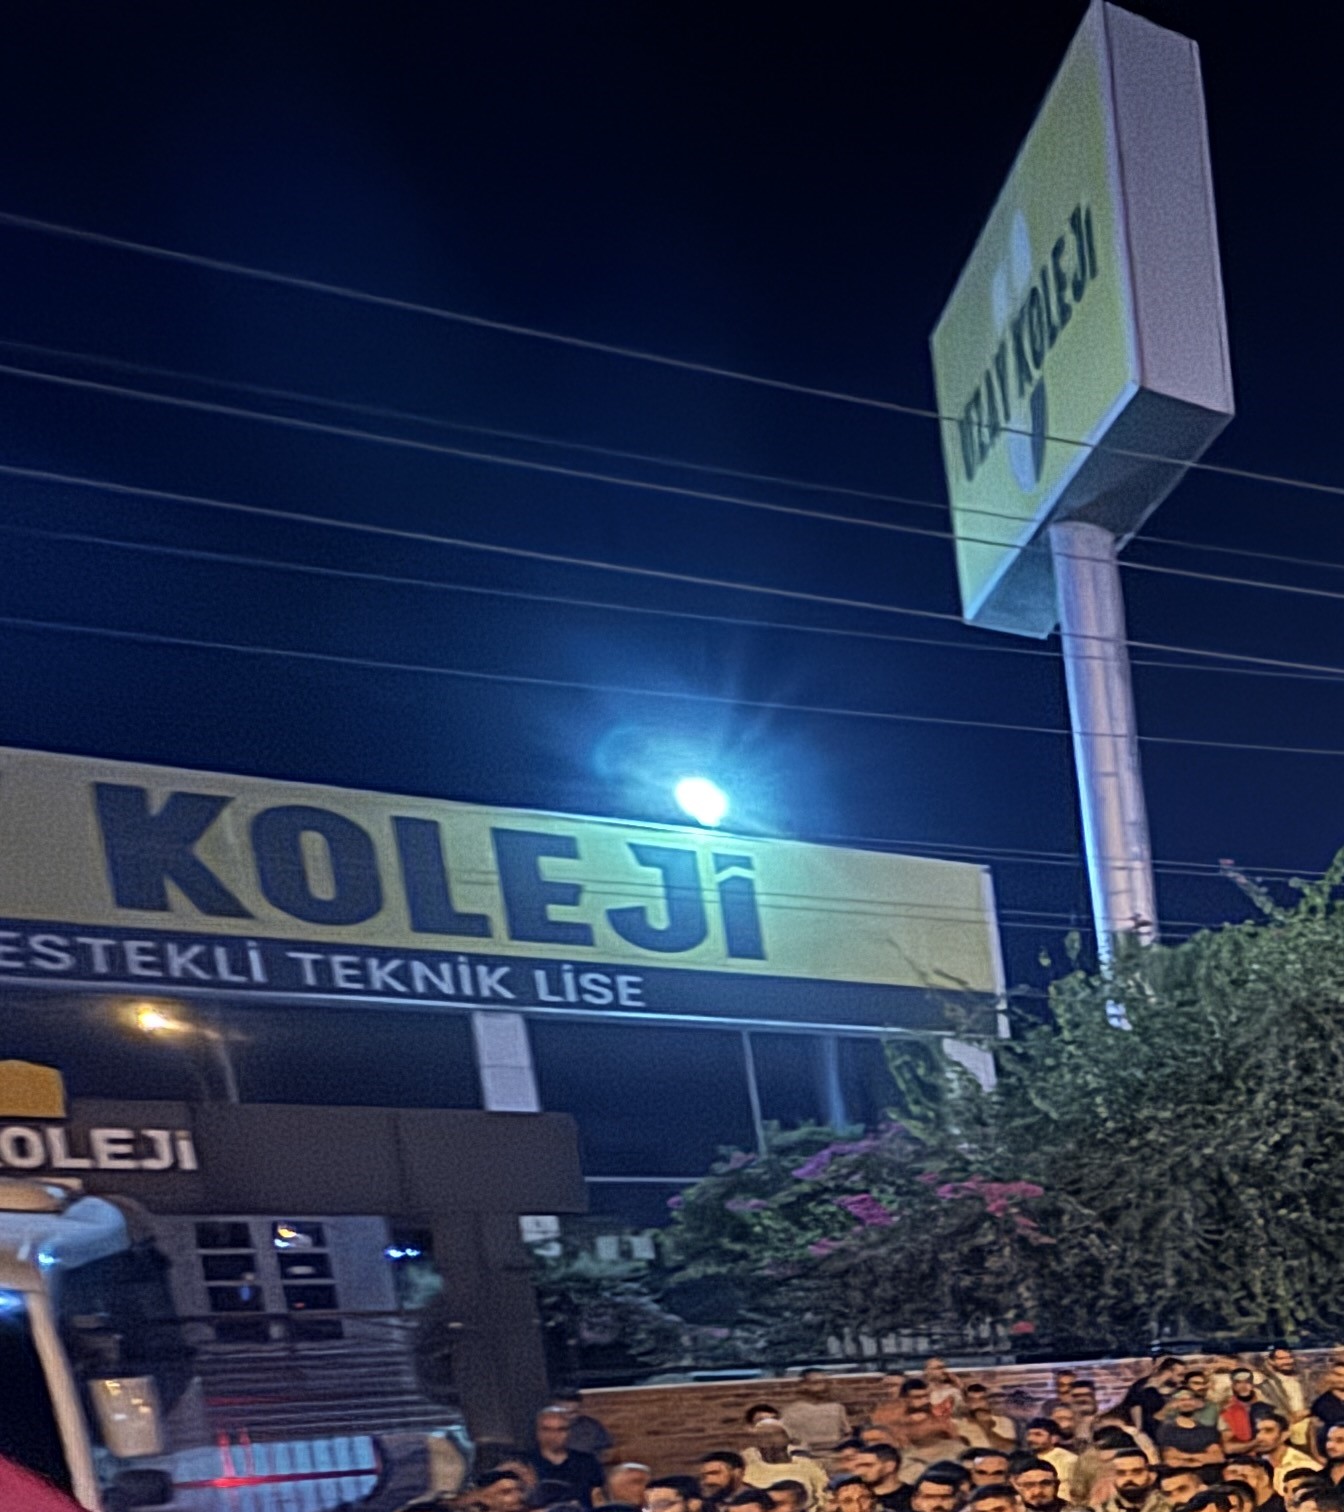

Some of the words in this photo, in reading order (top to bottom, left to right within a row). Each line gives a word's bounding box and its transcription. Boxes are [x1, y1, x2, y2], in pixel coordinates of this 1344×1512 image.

[286, 951, 516, 999] TEKNİK
[533, 964, 646, 1007] LİSE
[0, 1126, 198, 1170] OLEJİ
